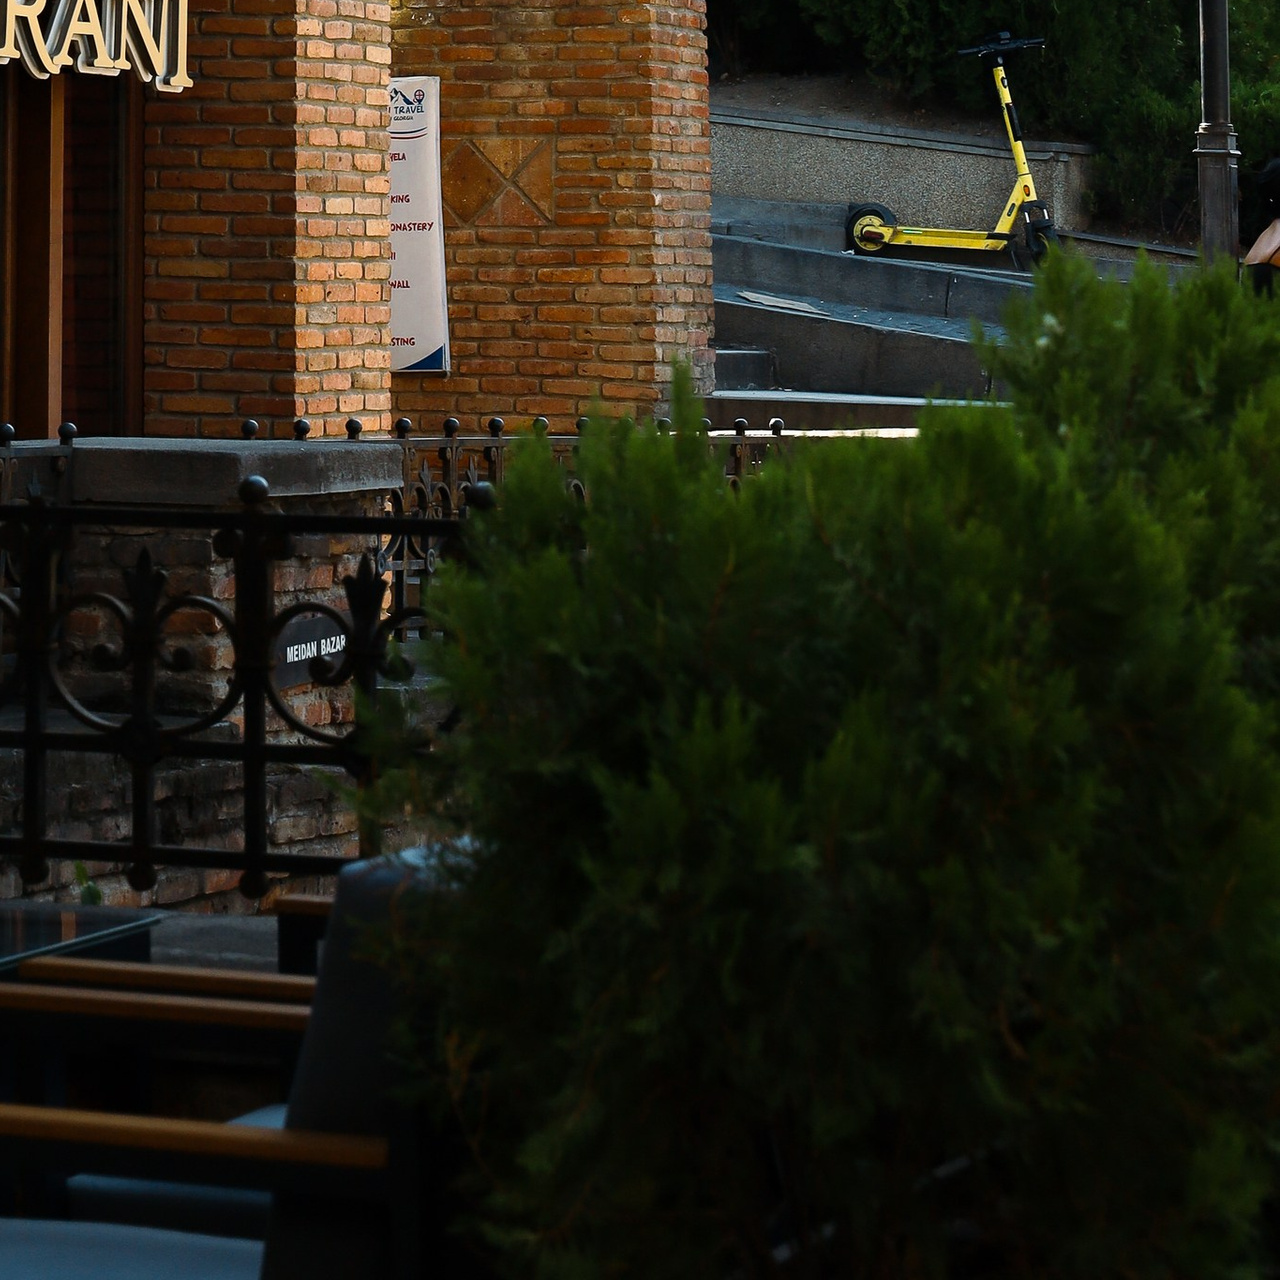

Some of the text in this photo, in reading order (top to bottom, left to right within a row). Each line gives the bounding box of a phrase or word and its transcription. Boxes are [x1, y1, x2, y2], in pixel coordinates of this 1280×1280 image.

[393, 105, 425, 114] TRAVEL
[390, 194, 410, 204] KING
[390, 221, 434, 232] ONASTERY
[389, 336, 415, 347] STING
[286, 634, 346, 663] MEIDAN BAZAR
